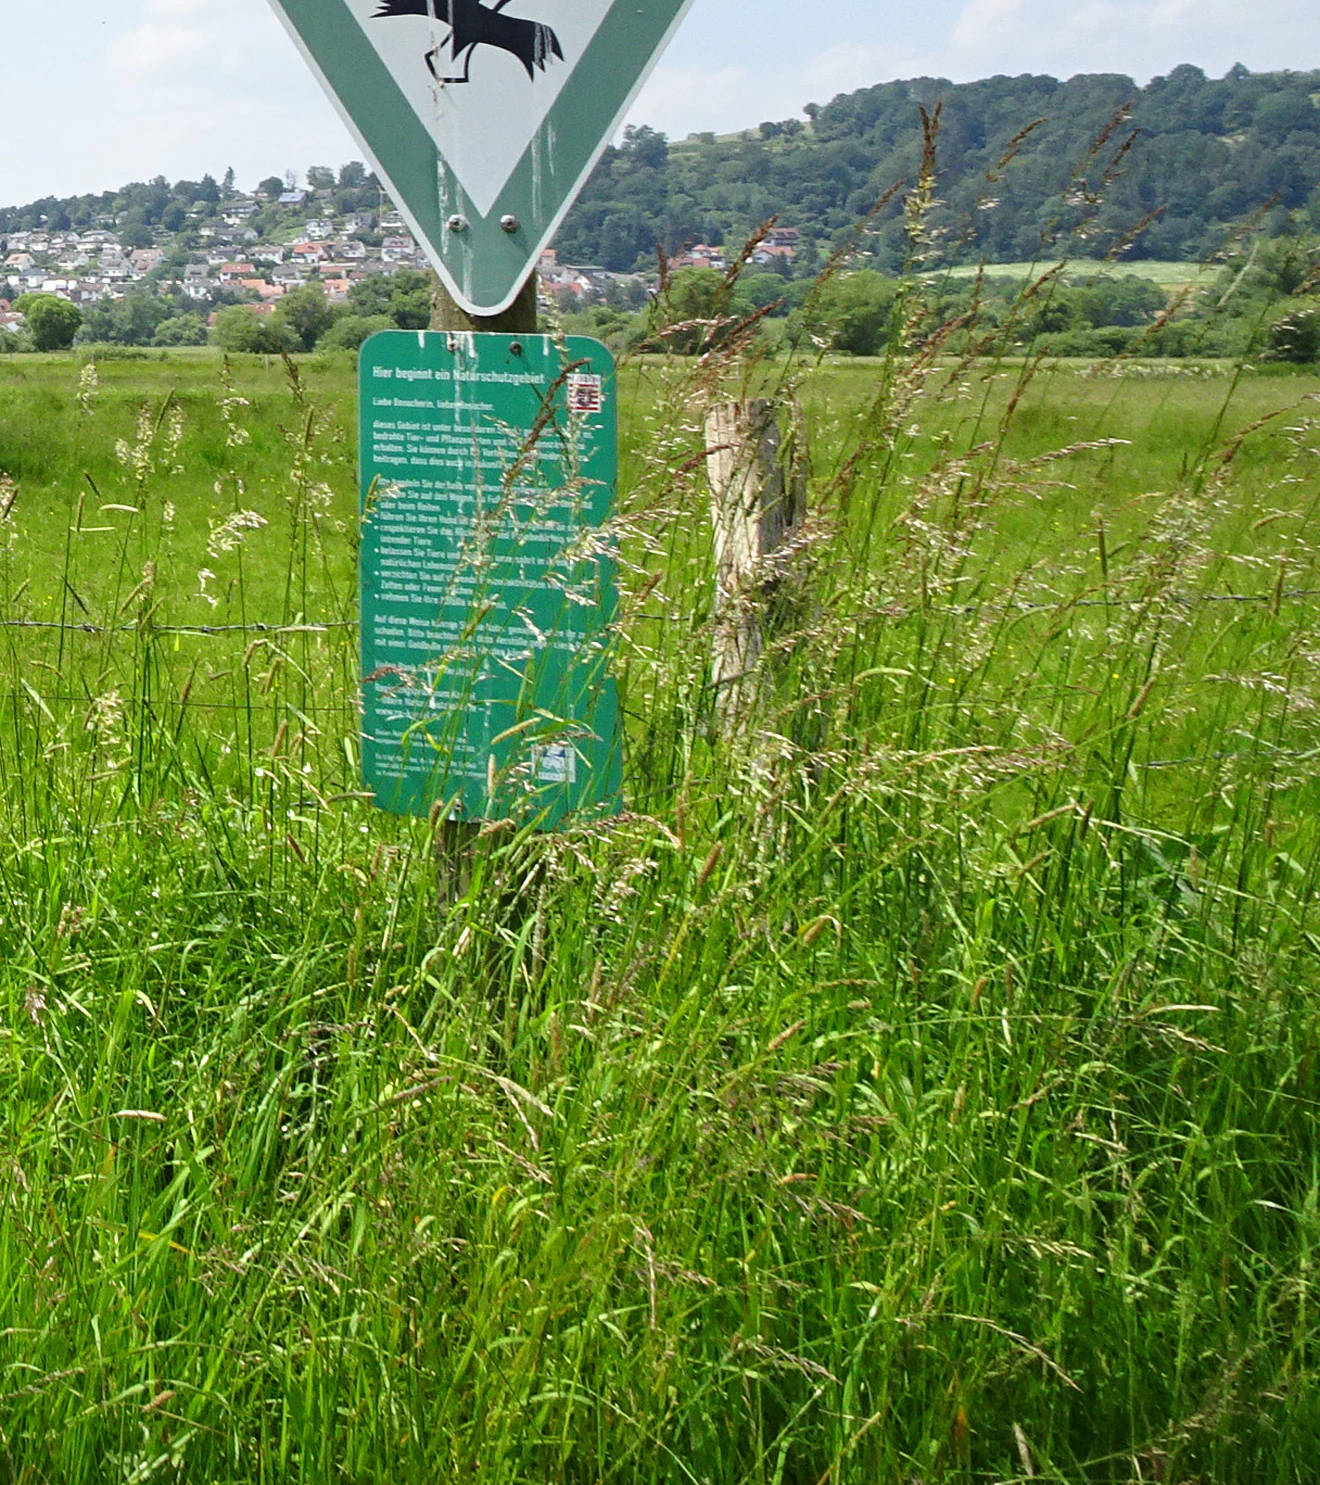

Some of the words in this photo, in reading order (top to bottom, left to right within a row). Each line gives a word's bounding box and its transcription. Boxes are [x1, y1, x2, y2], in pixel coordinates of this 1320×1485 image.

[372, 366, 393, 378] Hier
[395, 367, 433, 382] beginnt
[435, 368, 451, 380] ein
[453, 369, 545, 386] Naturschutzgebiet
